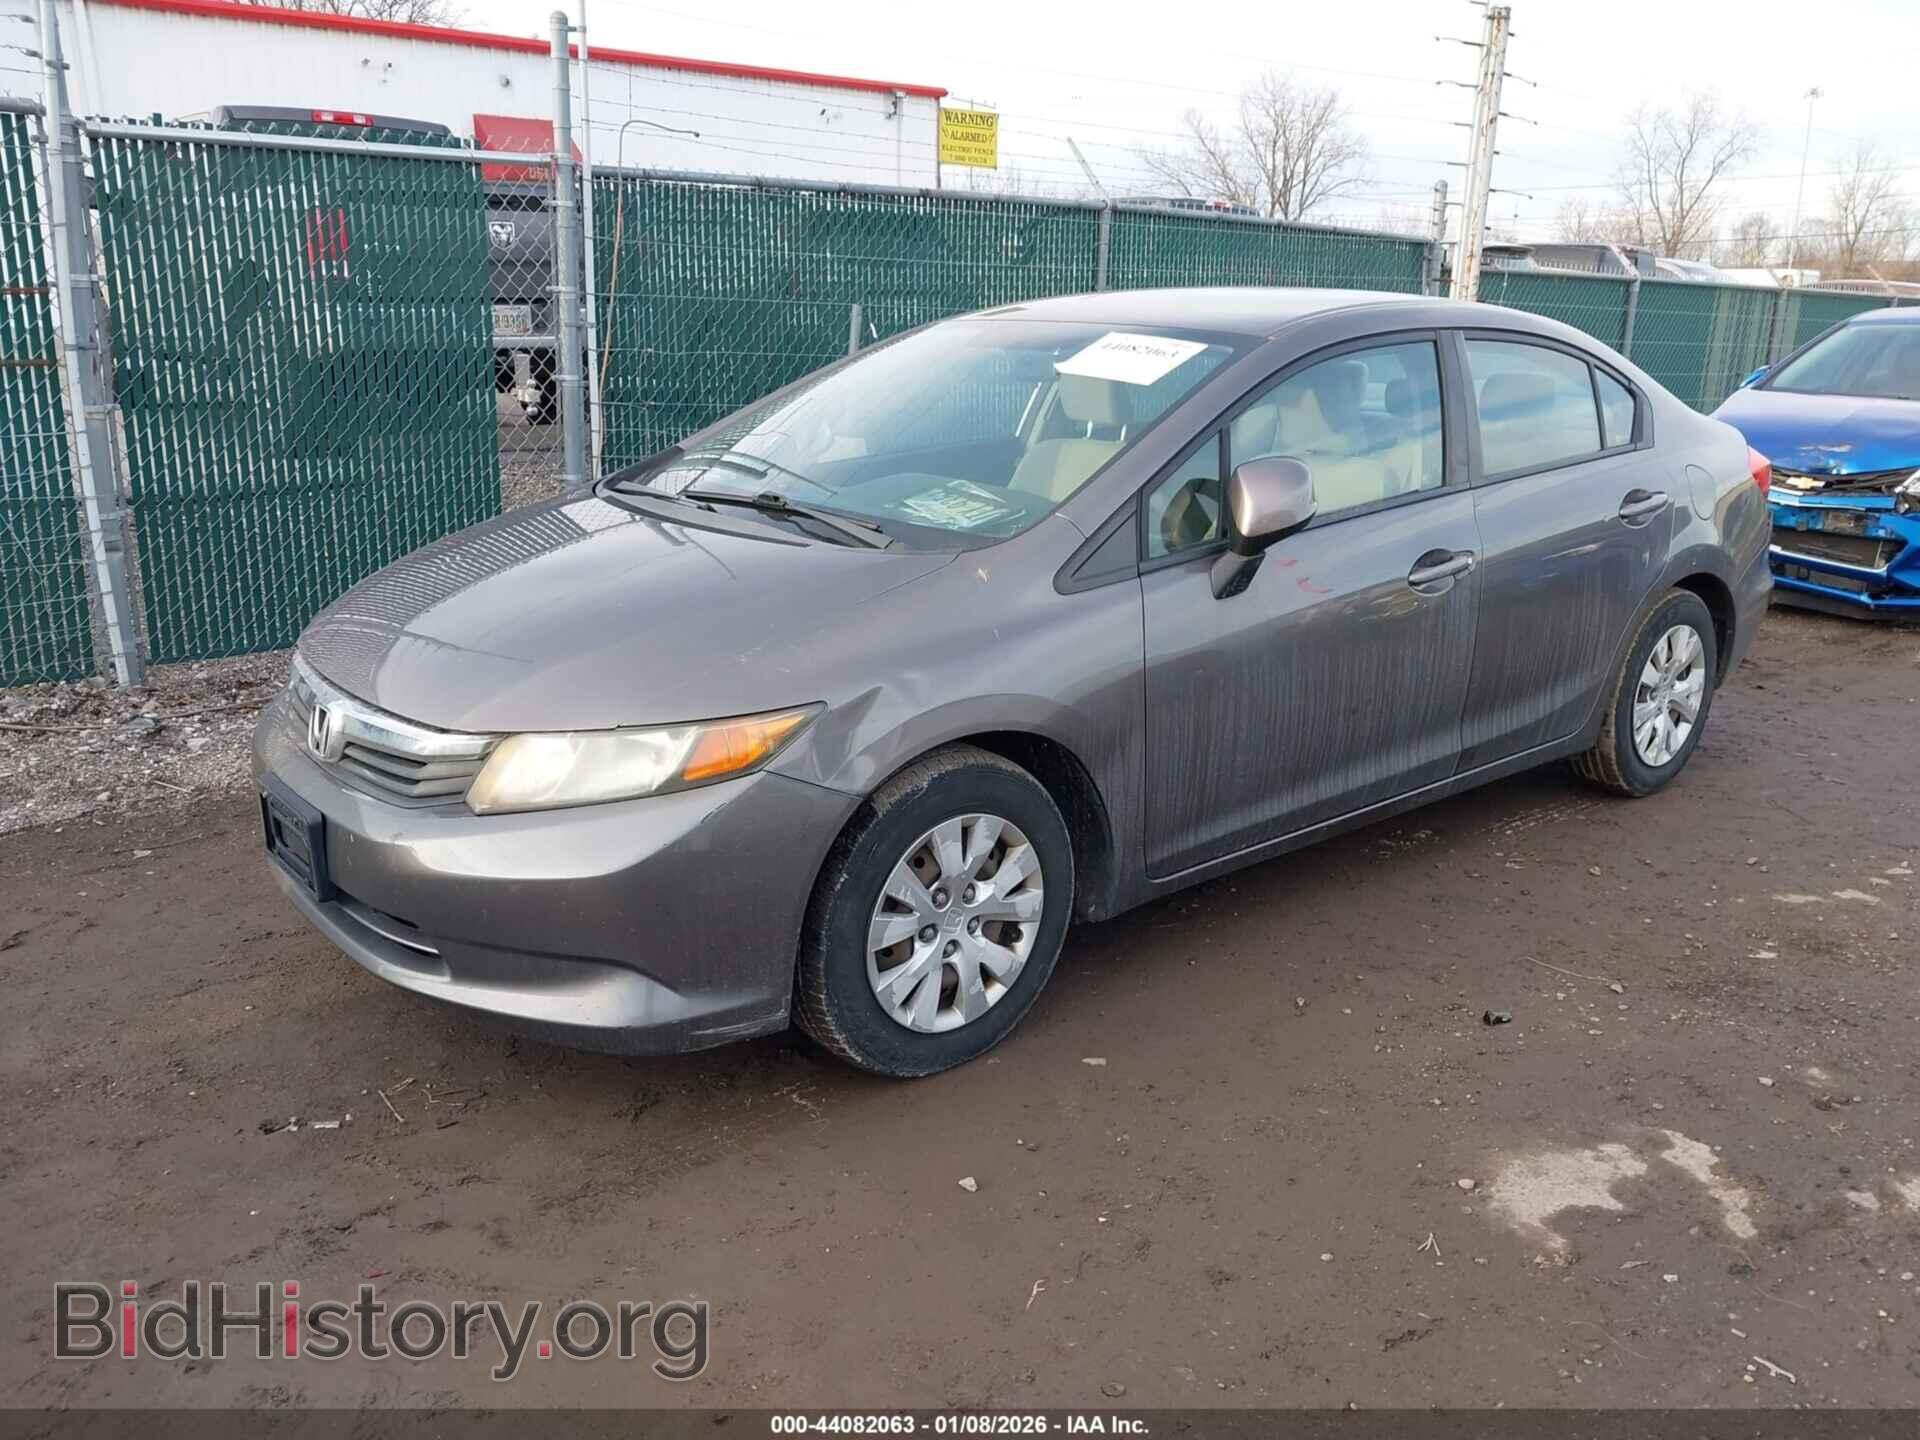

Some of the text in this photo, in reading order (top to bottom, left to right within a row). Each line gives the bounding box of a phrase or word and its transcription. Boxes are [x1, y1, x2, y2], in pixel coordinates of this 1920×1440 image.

[944, 111, 994, 128] WARNING
[951, 129, 987, 144] ALARMED
[942, 144, 993, 156] ELECTRIC FENCE
